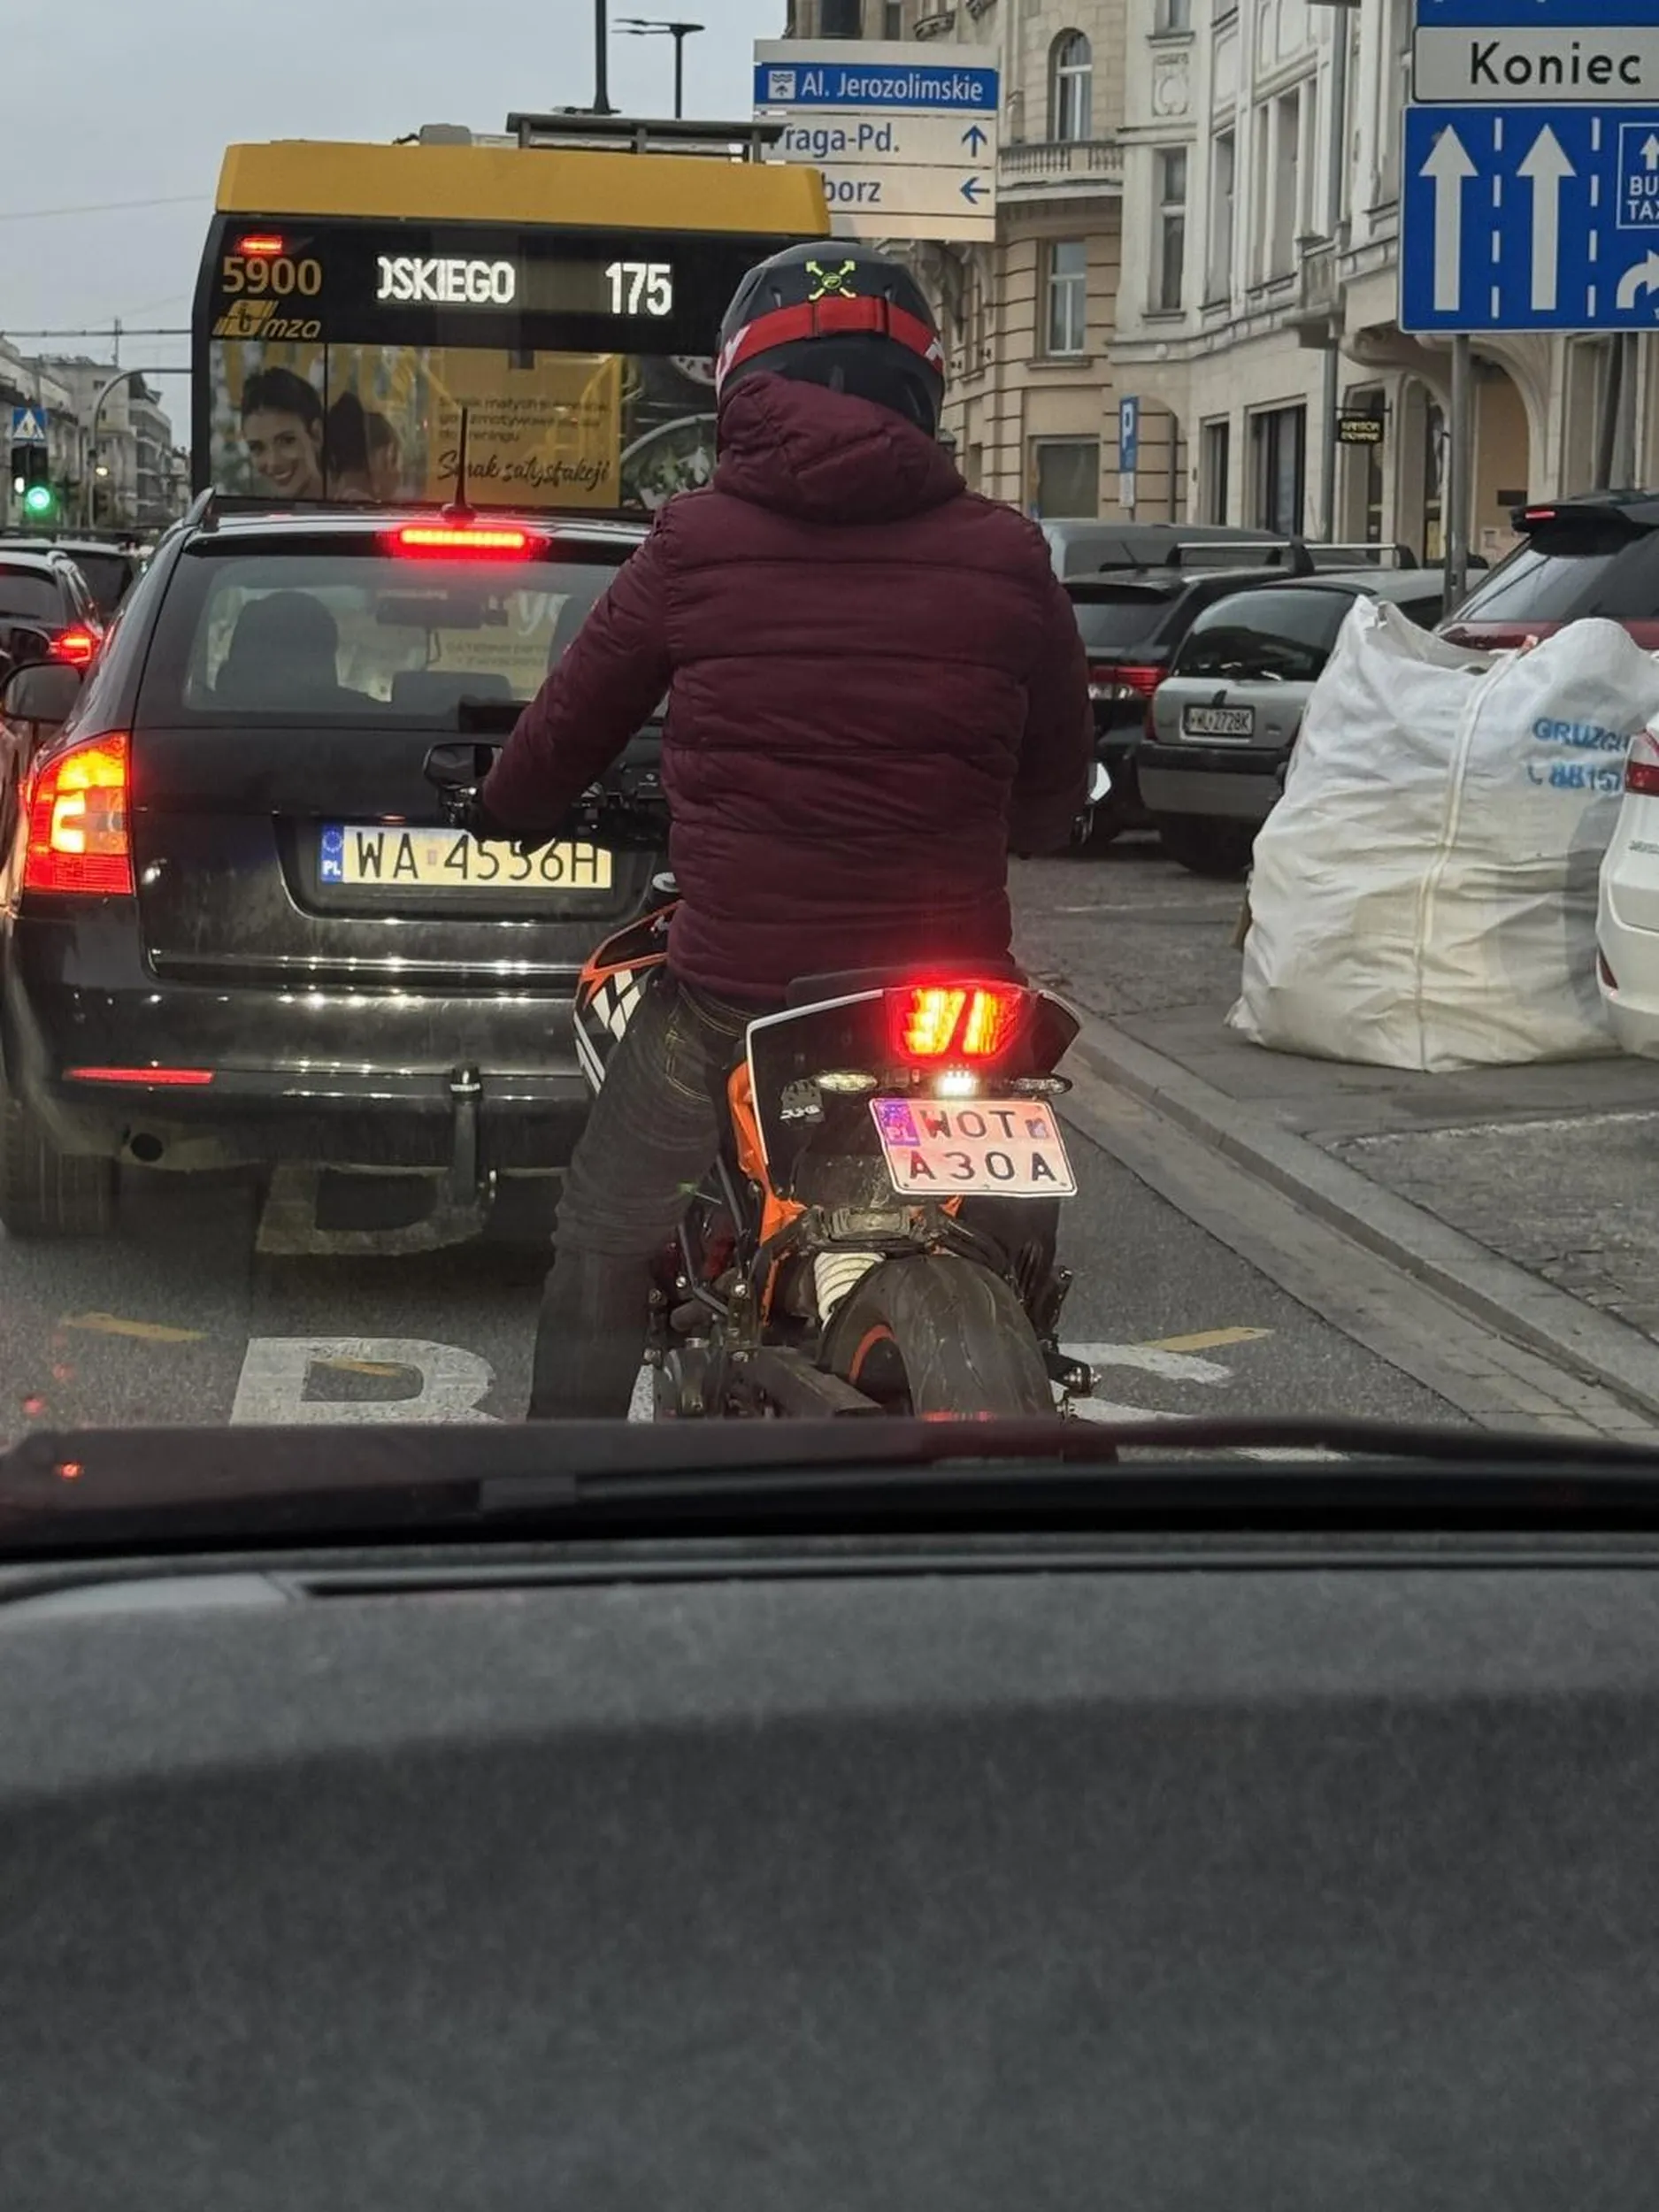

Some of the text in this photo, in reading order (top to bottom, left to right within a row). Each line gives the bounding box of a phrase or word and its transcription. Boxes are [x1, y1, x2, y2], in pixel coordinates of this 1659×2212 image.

[1470, 42, 1641, 86] Koniec
[801, 71, 984, 102] Al. Jerozolimskie
[768, 122, 900, 158] raga-Pd.
[1629, 175, 1659, 196] BU
[1626, 200, 1659, 220] TA
[222, 257, 322, 296] 5900
[604, 262, 672, 315] 175
[322, 860, 342, 876] PL
[356, 832, 419, 879] WA
[920, 1110, 1017, 1139] WOT
